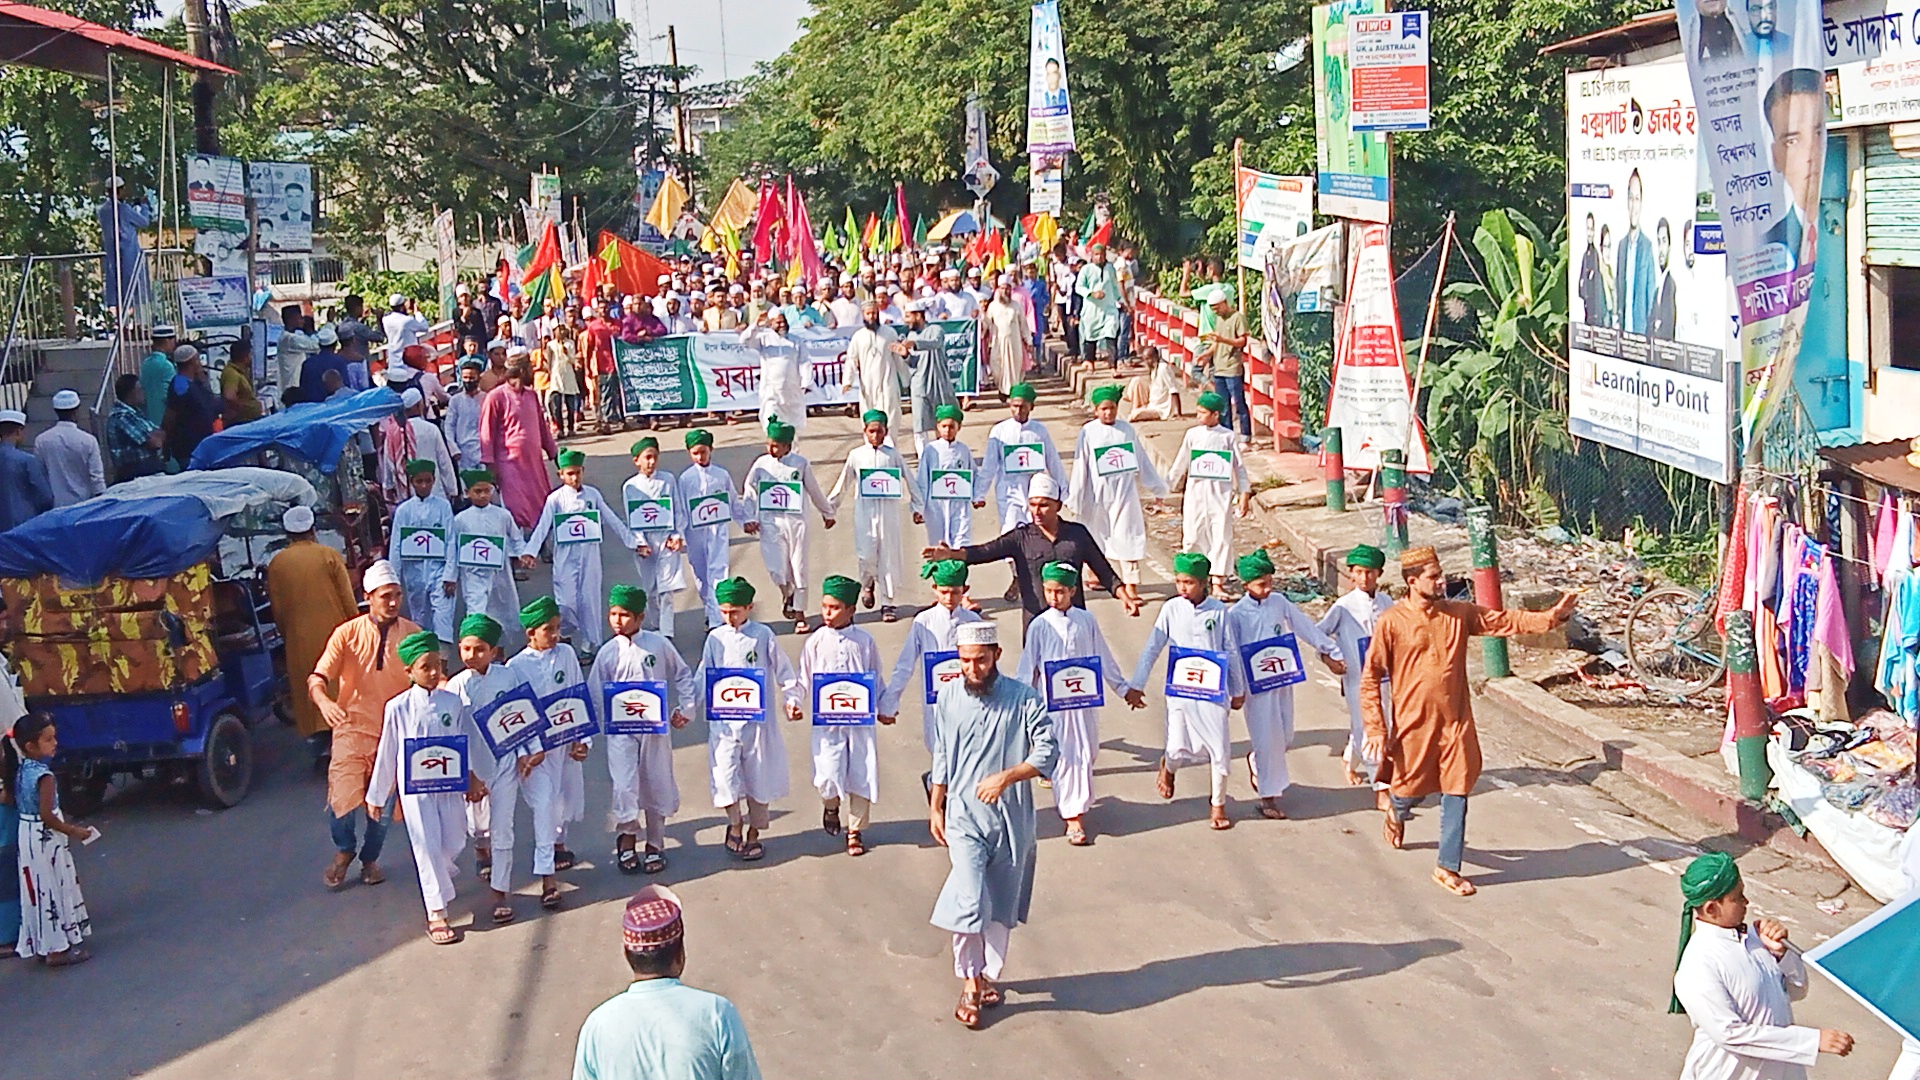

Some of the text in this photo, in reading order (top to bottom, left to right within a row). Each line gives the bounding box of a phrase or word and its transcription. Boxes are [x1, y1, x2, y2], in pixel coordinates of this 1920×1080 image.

[1358, 20, 1390, 32] NWC
[1843, 10, 1903, 56] সাদ্দাম
[1375, 43, 1416, 51] AUSTRALIA
[1580, 80, 1601, 97] IELTS
[1581, 102, 1628, 140] এক্সপার্ট
[1647, 99, 1682, 135] জনই
[1710, 113, 1743, 135] আসন্ন
[1593, 147, 1616, 161] IELTS
[1717, 142, 1757, 166] বিশ্বনাথ
[1725, 171, 1773, 197] পৌরসভা
[1730, 203, 1772, 227] নির্বাচনে
[1742, 280, 1789, 316] শামীম
[1594, 363, 1661, 408] Learning
[1665, 379, 1710, 414] Point
[1017, 451, 1030, 468] ন্ন
[1106, 450, 1125, 469] বী
[870, 478, 892, 493] লা
[943, 477, 958, 495] দু
[770, 487, 790, 508] মী
[642, 507, 660, 524] ঈ
[698, 502, 721, 521] দে
[567, 520, 586, 538] ত্র
[413, 534, 432, 554] প
[472, 540, 490, 561] বি
[1256, 657, 1287, 674] বী
[1061, 676, 1085, 694] দু
[1185, 668, 1208, 685] ন্ন
[720, 687, 755, 704] দে
[826, 694, 860, 711] মি
[550, 707, 576, 727] ত্র
[620, 701, 650, 719] ঈ
[498, 709, 526, 734] বি
[420, 756, 454, 775] প
